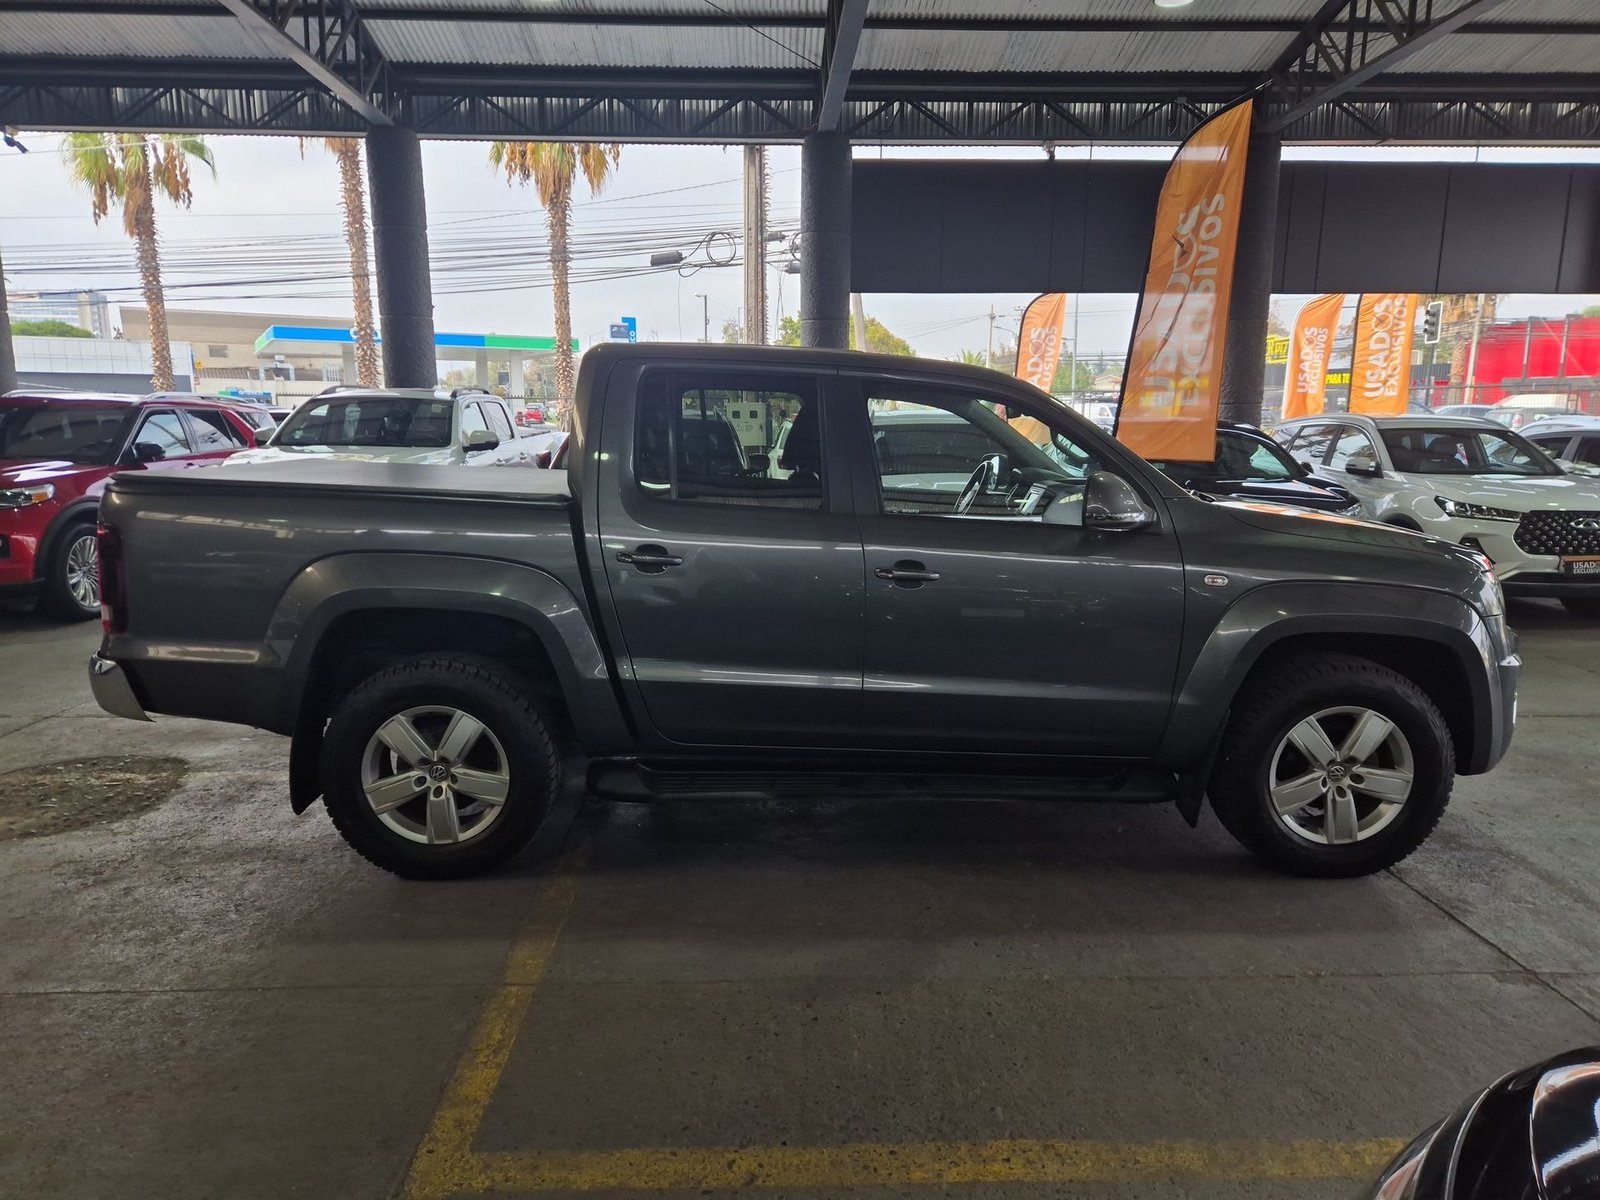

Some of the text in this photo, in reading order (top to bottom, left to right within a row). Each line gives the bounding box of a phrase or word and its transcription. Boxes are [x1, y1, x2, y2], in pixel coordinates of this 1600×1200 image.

[1139, 205, 1200, 408] USADOS
[1180, 193, 1225, 406] EXCLUSIVOS
[1027, 327, 1047, 388] ADOS
[1041, 325, 1058, 393] LUSIVOS
[1297, 327, 1318, 393] USADOS
[1307, 327, 1328, 394] EXCLUSIVOS
[1363, 298, 1393, 398] USADOS
[1385, 295, 1408, 397] EXCLUSIVOS
